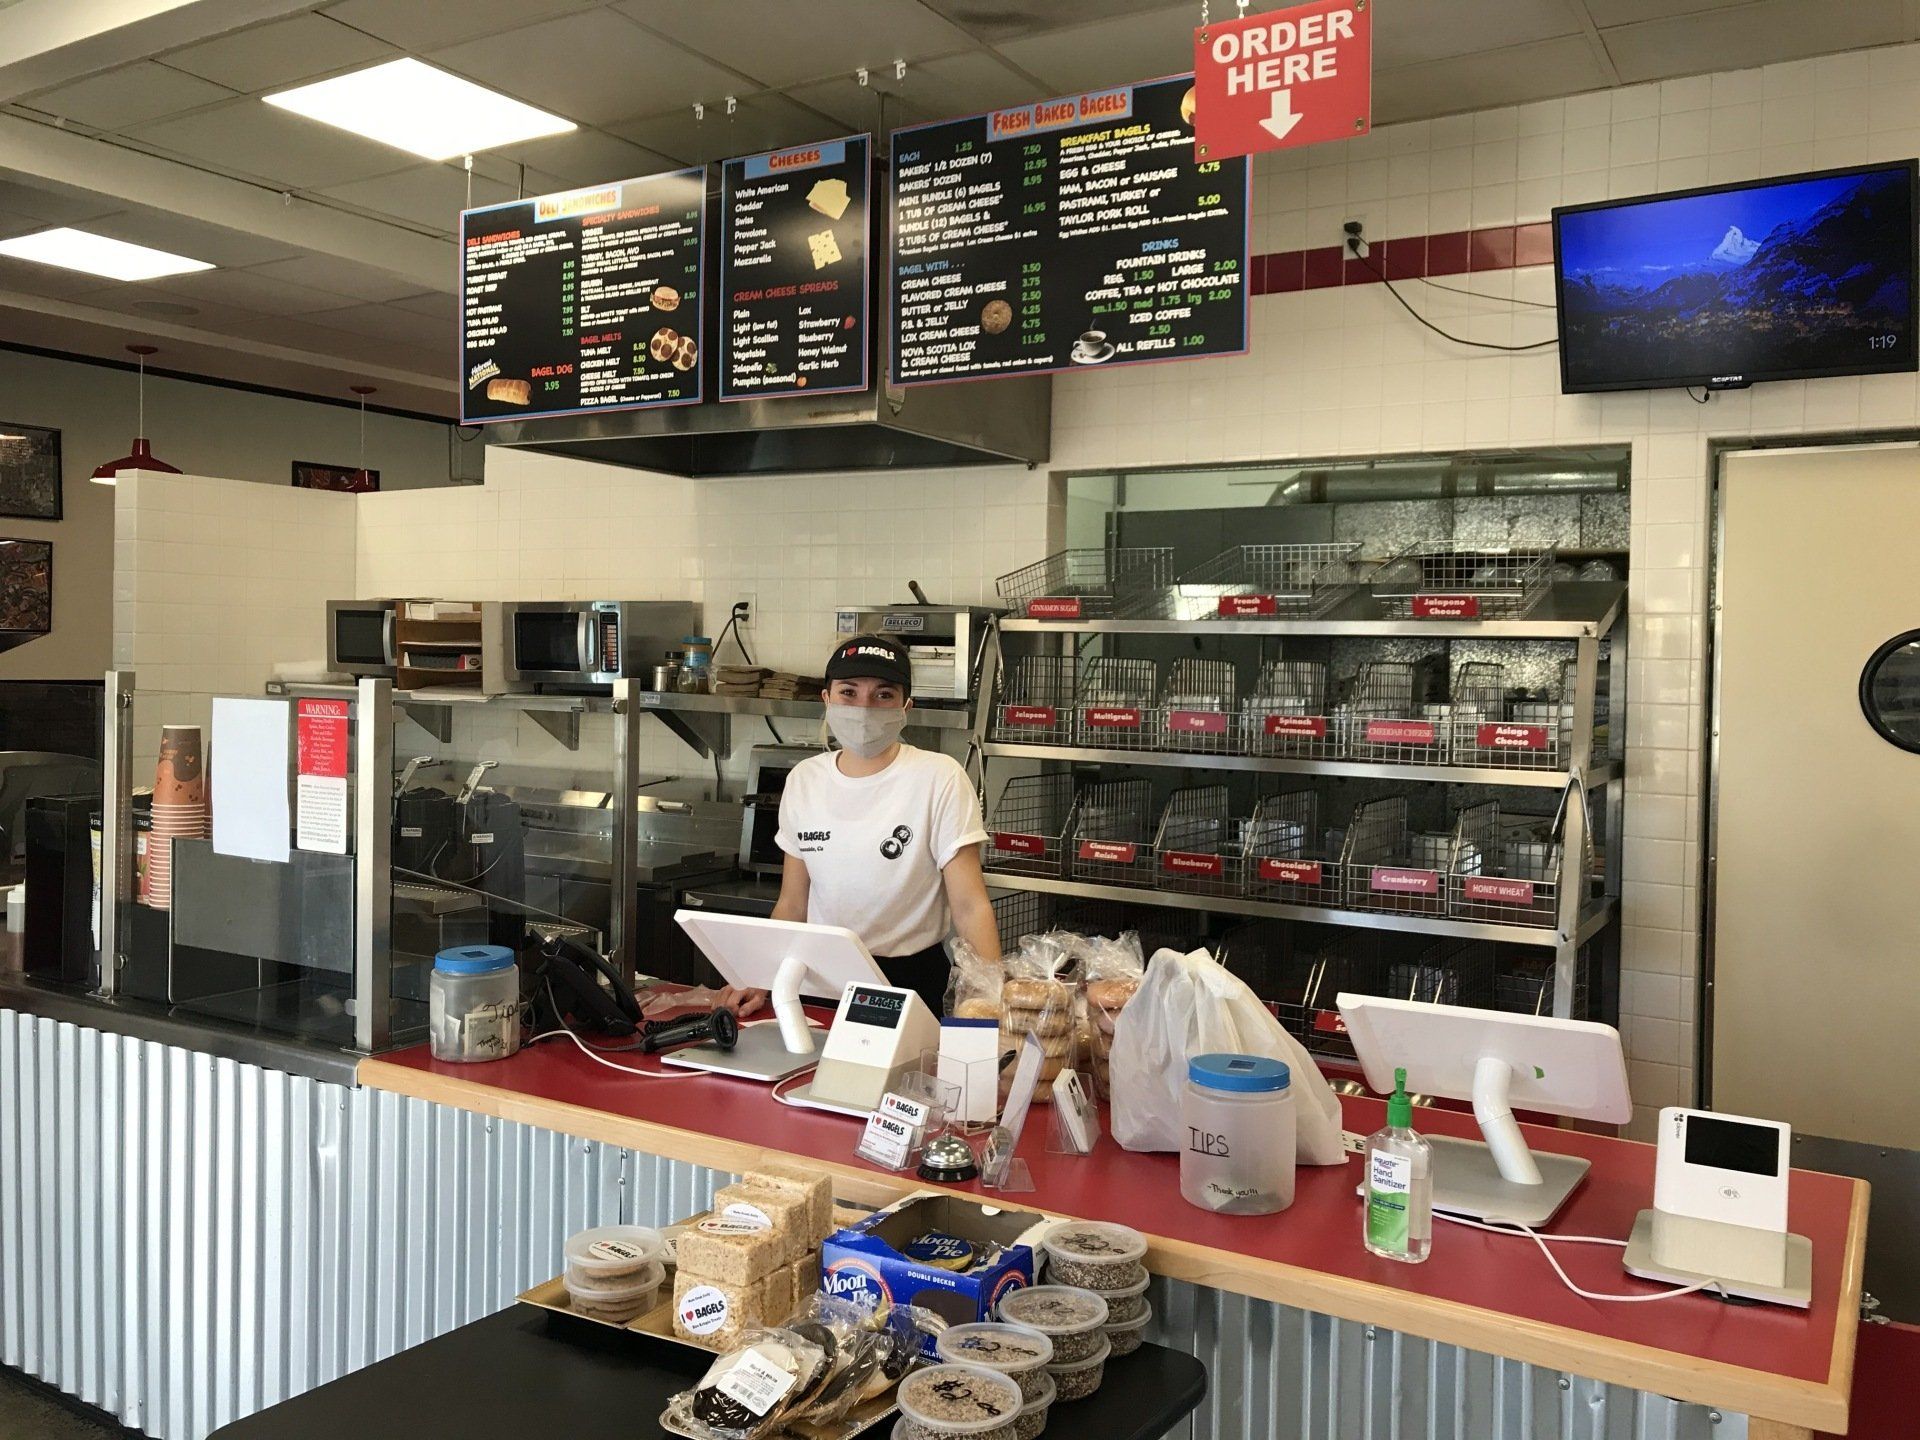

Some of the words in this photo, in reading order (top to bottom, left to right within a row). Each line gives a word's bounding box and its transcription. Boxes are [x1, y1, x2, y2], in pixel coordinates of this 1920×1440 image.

[1212, 9, 1354, 64] ORDER
[1227, 47, 1337, 96] HERE
[993, 108, 1030, 132] FRESH
[1034, 102, 1075, 125] BAKED
[1080, 93, 1126, 117] BAGELS
[1060, 130, 1111, 148] BREAKFAST
[1114, 124, 1150, 139] BAGELS
[900, 151, 920, 163] EACH
[955, 141, 973, 153] 1.25
[769, 150, 820, 169] CHEESES
[934, 173, 962, 187] DOZEN
[1024, 158, 1048, 171] 12.95
[1059, 167, 1079, 180] EGG
[1081, 166, 1089, 176] &
[1091, 160, 1127, 175] CHEESE
[735, 187, 756, 200] White
[757, 183, 789, 197] American
[735, 201, 764, 213] Cheddar
[1059, 211, 1094, 227] TAYLOR
[1096, 207, 1123, 222] PORK
[1125, 204, 1150, 217] ROLL
[1198, 193, 1221, 207] 5.00
[582, 214, 615, 226] SPECIALTY
[618, 205, 660, 220] SANDWICHES
[467, 237, 480, 247] DELI
[482, 230, 520, 244] SANDWICHES
[735, 228, 767, 241] Provolone
[1142, 238, 1180, 253] DRINKS
[734, 254, 772, 268] Mozzarella
[1116, 253, 1166, 270] FOUNTAIN
[1168, 248, 1207, 263] DRINKS
[899, 263, 924, 276] BAGEL
[926, 260, 949, 272] WITH
[1103, 274, 1125, 285] REG.
[1134, 269, 1155, 282] 1.50
[1172, 263, 1205, 277] LARGE
[1214, 259, 1238, 272] 2.00
[901, 278, 930, 291] CREAM
[931, 273, 962, 286] CHEESE
[1022, 262, 1042, 274] 3.50
[733, 290, 763, 302] CREAM
[765, 285, 797, 299] CHEESE
[799, 280, 839, 294] SPREADS
[901, 289, 942, 304] FLAVORED
[944, 285, 974, 298] CREAM
[975, 280, 1007, 294] CHEESE
[1022, 276, 1041, 288] 3.75
[733, 309, 750, 319] Plain
[798, 306, 812, 316] Lox
[1129, 312, 1153, 324] ICED
[1155, 307, 1192, 321] COFFEE
[466, 318, 481, 328] TUNA
[482, 316, 499, 326] SALAD
[798, 317, 841, 330] Strawberry
[489, 325, 508, 336] SALAD
[901, 332, 917, 344] LOX
[919, 329, 948, 342] CREAM
[949, 325, 981, 338] CHEESE
[1022, 318, 1041, 330] 4.75
[1149, 324, 1171, 336] 2.50
[733, 336, 751, 348] Light
[752, 334, 779, 345] Scallion
[798, 332, 834, 343] Blueberry
[1116, 342, 1135, 353] ALL
[1137, 338, 1176, 351] REFILLS
[1183, 335, 1205, 346] 1.00
[1868, 334, 1897, 350] 1:19
[580, 348, 596, 357] TUNA
[798, 347, 821, 361] Honey
[821, 343, 848, 356] Walnut
[901, 346, 924, 358] NOVA
[926, 343, 958, 355] SCOTIA
[959, 341, 976, 351] LOX
[1022, 333, 1046, 345] 11.95
[733, 348, 767, 362] Vegetable
[531, 366, 555, 378] BAGEL
[556, 363, 573, 375] DOG
[544, 380, 560, 391] 3.95
[1030, 604, 1060, 613] CINNAMON
[1059, 604, 1078, 613] SUGAR
[1233, 597, 1261, 606] French
[1237, 605, 1259, 614] Toast
[1429, 607, 1462, 616] Cheese
[857, 646, 895, 660] BAGELS
[305, 703, 341, 716] WARNING:
[1093, 711, 1134, 722] Multigrain
[1189, 717, 1205, 727] Egg
[1279, 716, 1313, 727] Spinach
[1274, 726, 1317, 737] Parmesan
[1368, 727, 1403, 737] CHEDDAR
[1403, 728, 1433, 739] CHEESE
[1495, 726, 1529, 738] Asiago
[1495, 736, 1529, 747] Cheese
[803, 830, 831, 842] BAGELS
[1010, 838, 1030, 848] Plain
[1089, 842, 1127, 852] Cinnamon
[1094, 851, 1118, 860] Raisin
[1172, 857, 1214, 870] Blueberry
[1269, 859, 1312, 871] Chocolate
[1280, 870, 1300, 881] Chip
[1380, 874, 1429, 888] Cranberry
[1472, 883, 1497, 896] HONEY
[1498, 885, 1526, 897] WHEAT
[869, 995, 904, 1010] BAGELS
[895, 1101, 919, 1117] BAGELS
[882, 1119, 905, 1136] BAGELS
[1188, 1126, 1230, 1156] TIPS
[1373, 1166, 1393, 1178] Hand
[1373, 1174, 1407, 1190] Sanitizer
[720, 1223, 760, 1231] BAGELS
[912, 1233, 961, 1247] Moon
[607, 1245, 638, 1259] BAGELS
[930, 1244, 964, 1258] Pie
[823, 1273, 867, 1296] Moon
[907, 1270, 931, 1282] DOUBLE
[932, 1276, 956, 1288] DECKER
[852, 1290, 878, 1306] Pie
[681, 1313, 686, 1324] I
[694, 1299, 725, 1319] BAGELS
